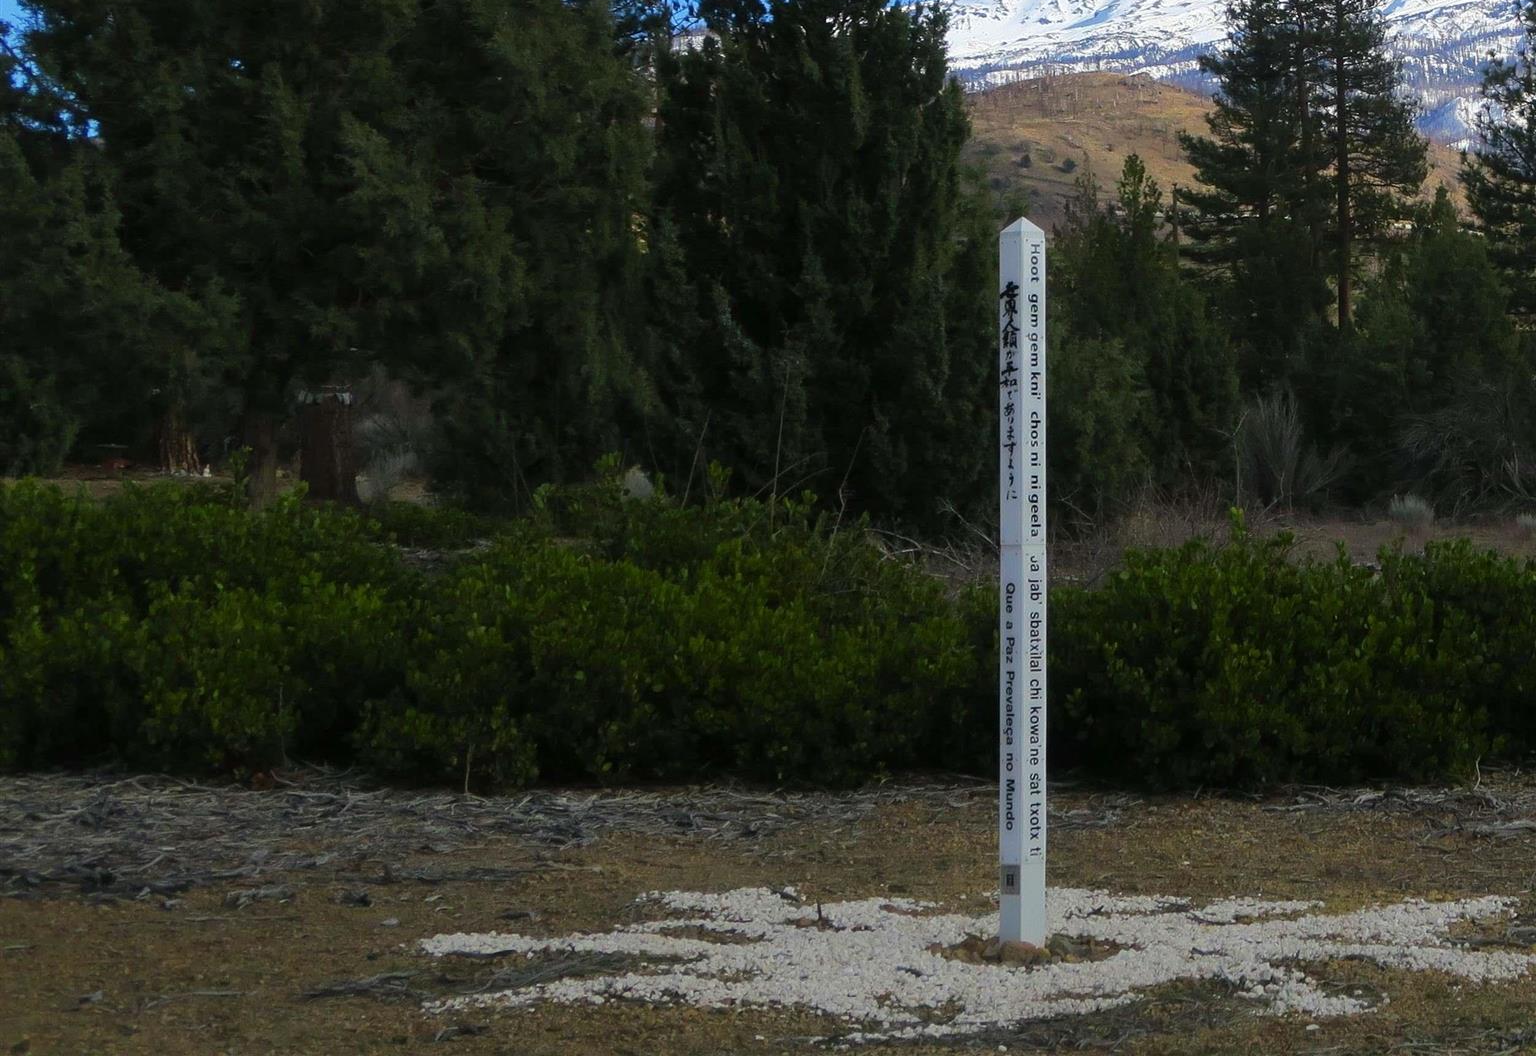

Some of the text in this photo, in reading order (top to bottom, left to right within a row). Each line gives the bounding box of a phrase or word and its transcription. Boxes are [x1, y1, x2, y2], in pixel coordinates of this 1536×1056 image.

[1029, 243, 1041, 283] Hoot
[1027, 293, 1040, 328] gem
[1027, 332, 1040, 368] gem
[1030, 411, 1043, 448] chos
[1030, 452, 1042, 467] ni
[1030, 474, 1042, 490] ni
[1027, 493, 1042, 538] geela
[1029, 611, 1044, 673] sbatxilal
[1002, 582, 1016, 831] Que a Paz Prevaleça no Mundo
[1029, 678, 1043, 700] chi
[1029, 801, 1042, 840] txotx
[1030, 846, 1043, 857] ti
